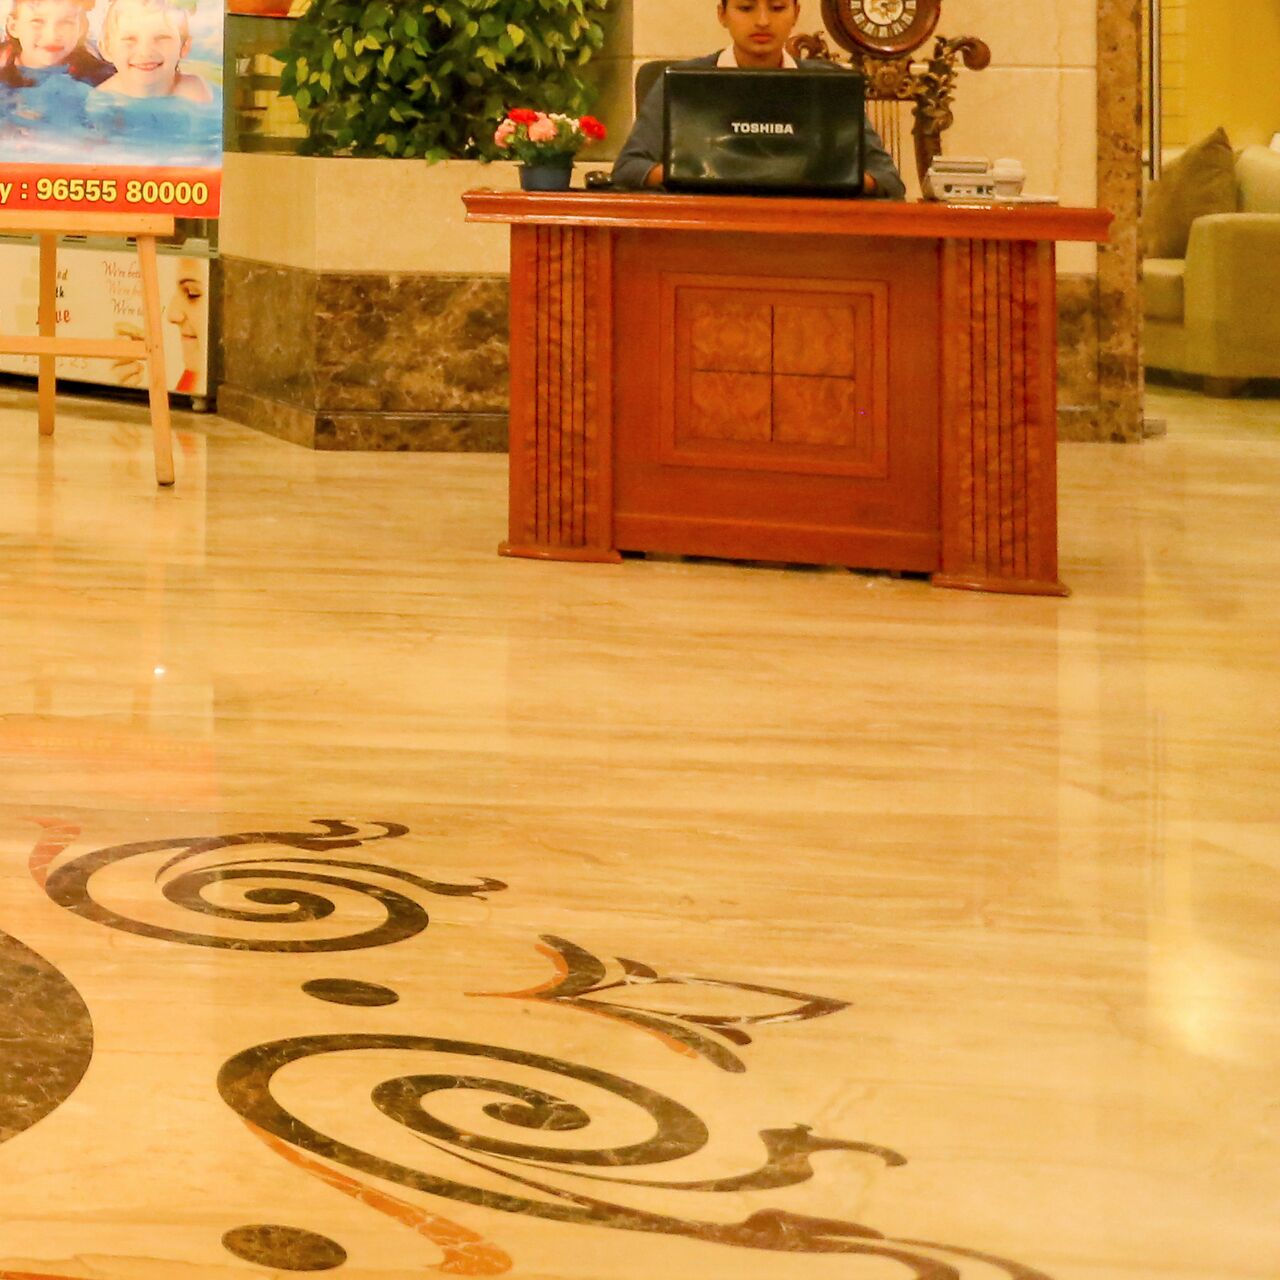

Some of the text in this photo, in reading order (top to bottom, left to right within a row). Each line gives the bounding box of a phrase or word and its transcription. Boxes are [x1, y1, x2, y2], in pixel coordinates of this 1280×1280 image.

[731, 122, 794, 135] TOSHIBA
[36, 177, 118, 202] 96555
[124, 179, 209, 206] 80000
